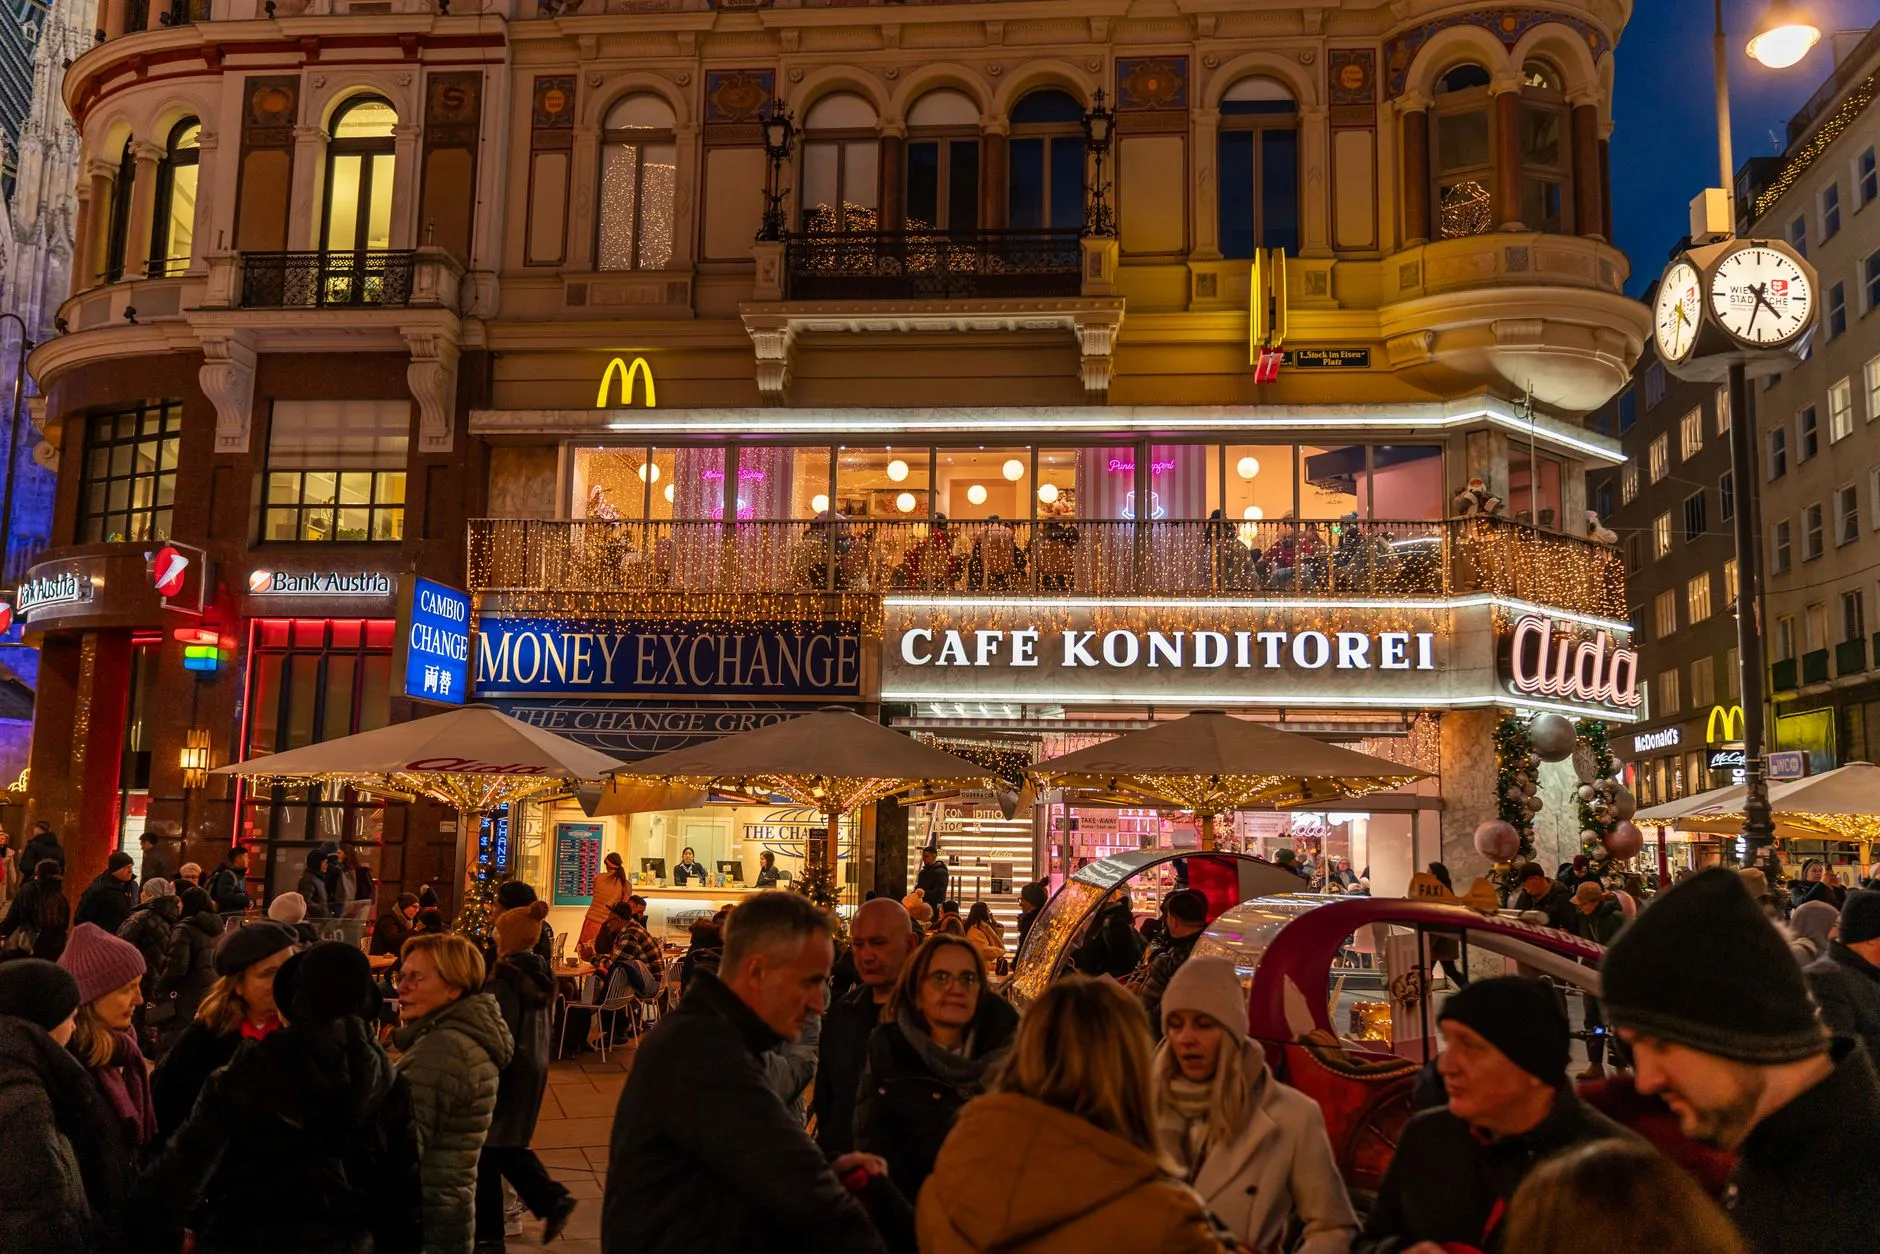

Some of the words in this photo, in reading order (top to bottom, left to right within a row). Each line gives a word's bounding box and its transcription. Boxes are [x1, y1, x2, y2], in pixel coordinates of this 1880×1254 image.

[1730, 285, 1770, 296] WIER
[38, 571, 75, 601] Austria
[273, 571, 321, 592] Bank
[325, 571, 390, 593] Austria
[421, 590, 466, 623] CAMBIO
[411, 622, 468, 662] CHANGE
[900, 626, 1039, 668] CAFÉ
[1061, 629, 1435, 670] KONDITOREI
[475, 631, 624, 686] MONEY
[633, 633, 860, 689] EXCHANGE
[424, 664, 452, 696] 両替
[508, 709, 568, 729] THE
[573, 710, 706, 732] CHANGE
[1634, 728, 1679, 752] McDonald's
[743, 826, 774, 840] THE
